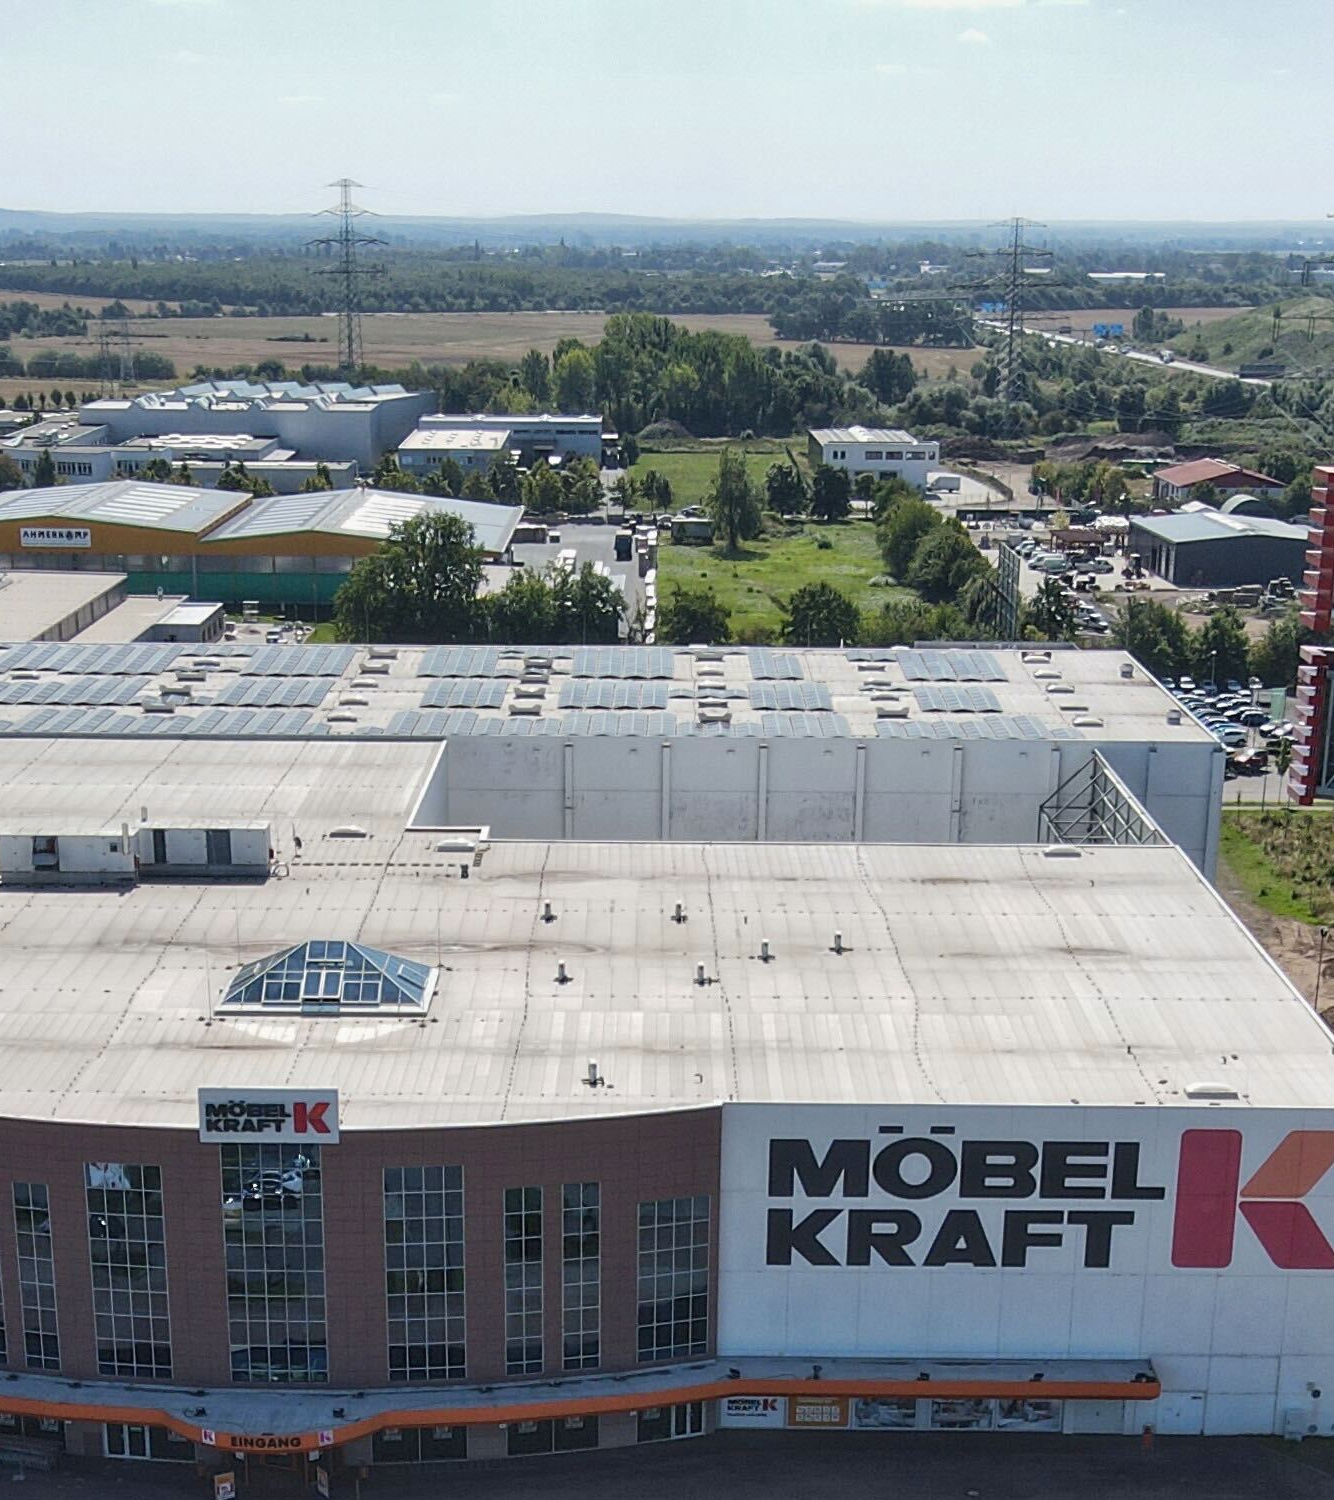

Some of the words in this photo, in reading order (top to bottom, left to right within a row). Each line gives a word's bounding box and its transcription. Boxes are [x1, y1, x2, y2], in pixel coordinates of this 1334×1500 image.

[205, 1100, 292, 1118] MÖBEL
[205, 1118, 286, 1133] KRAFT
[768, 1125, 1166, 1201] MÖBEL
[765, 1208, 1136, 1268] KRAFT
[230, 1436, 301, 1449] EINGANG
